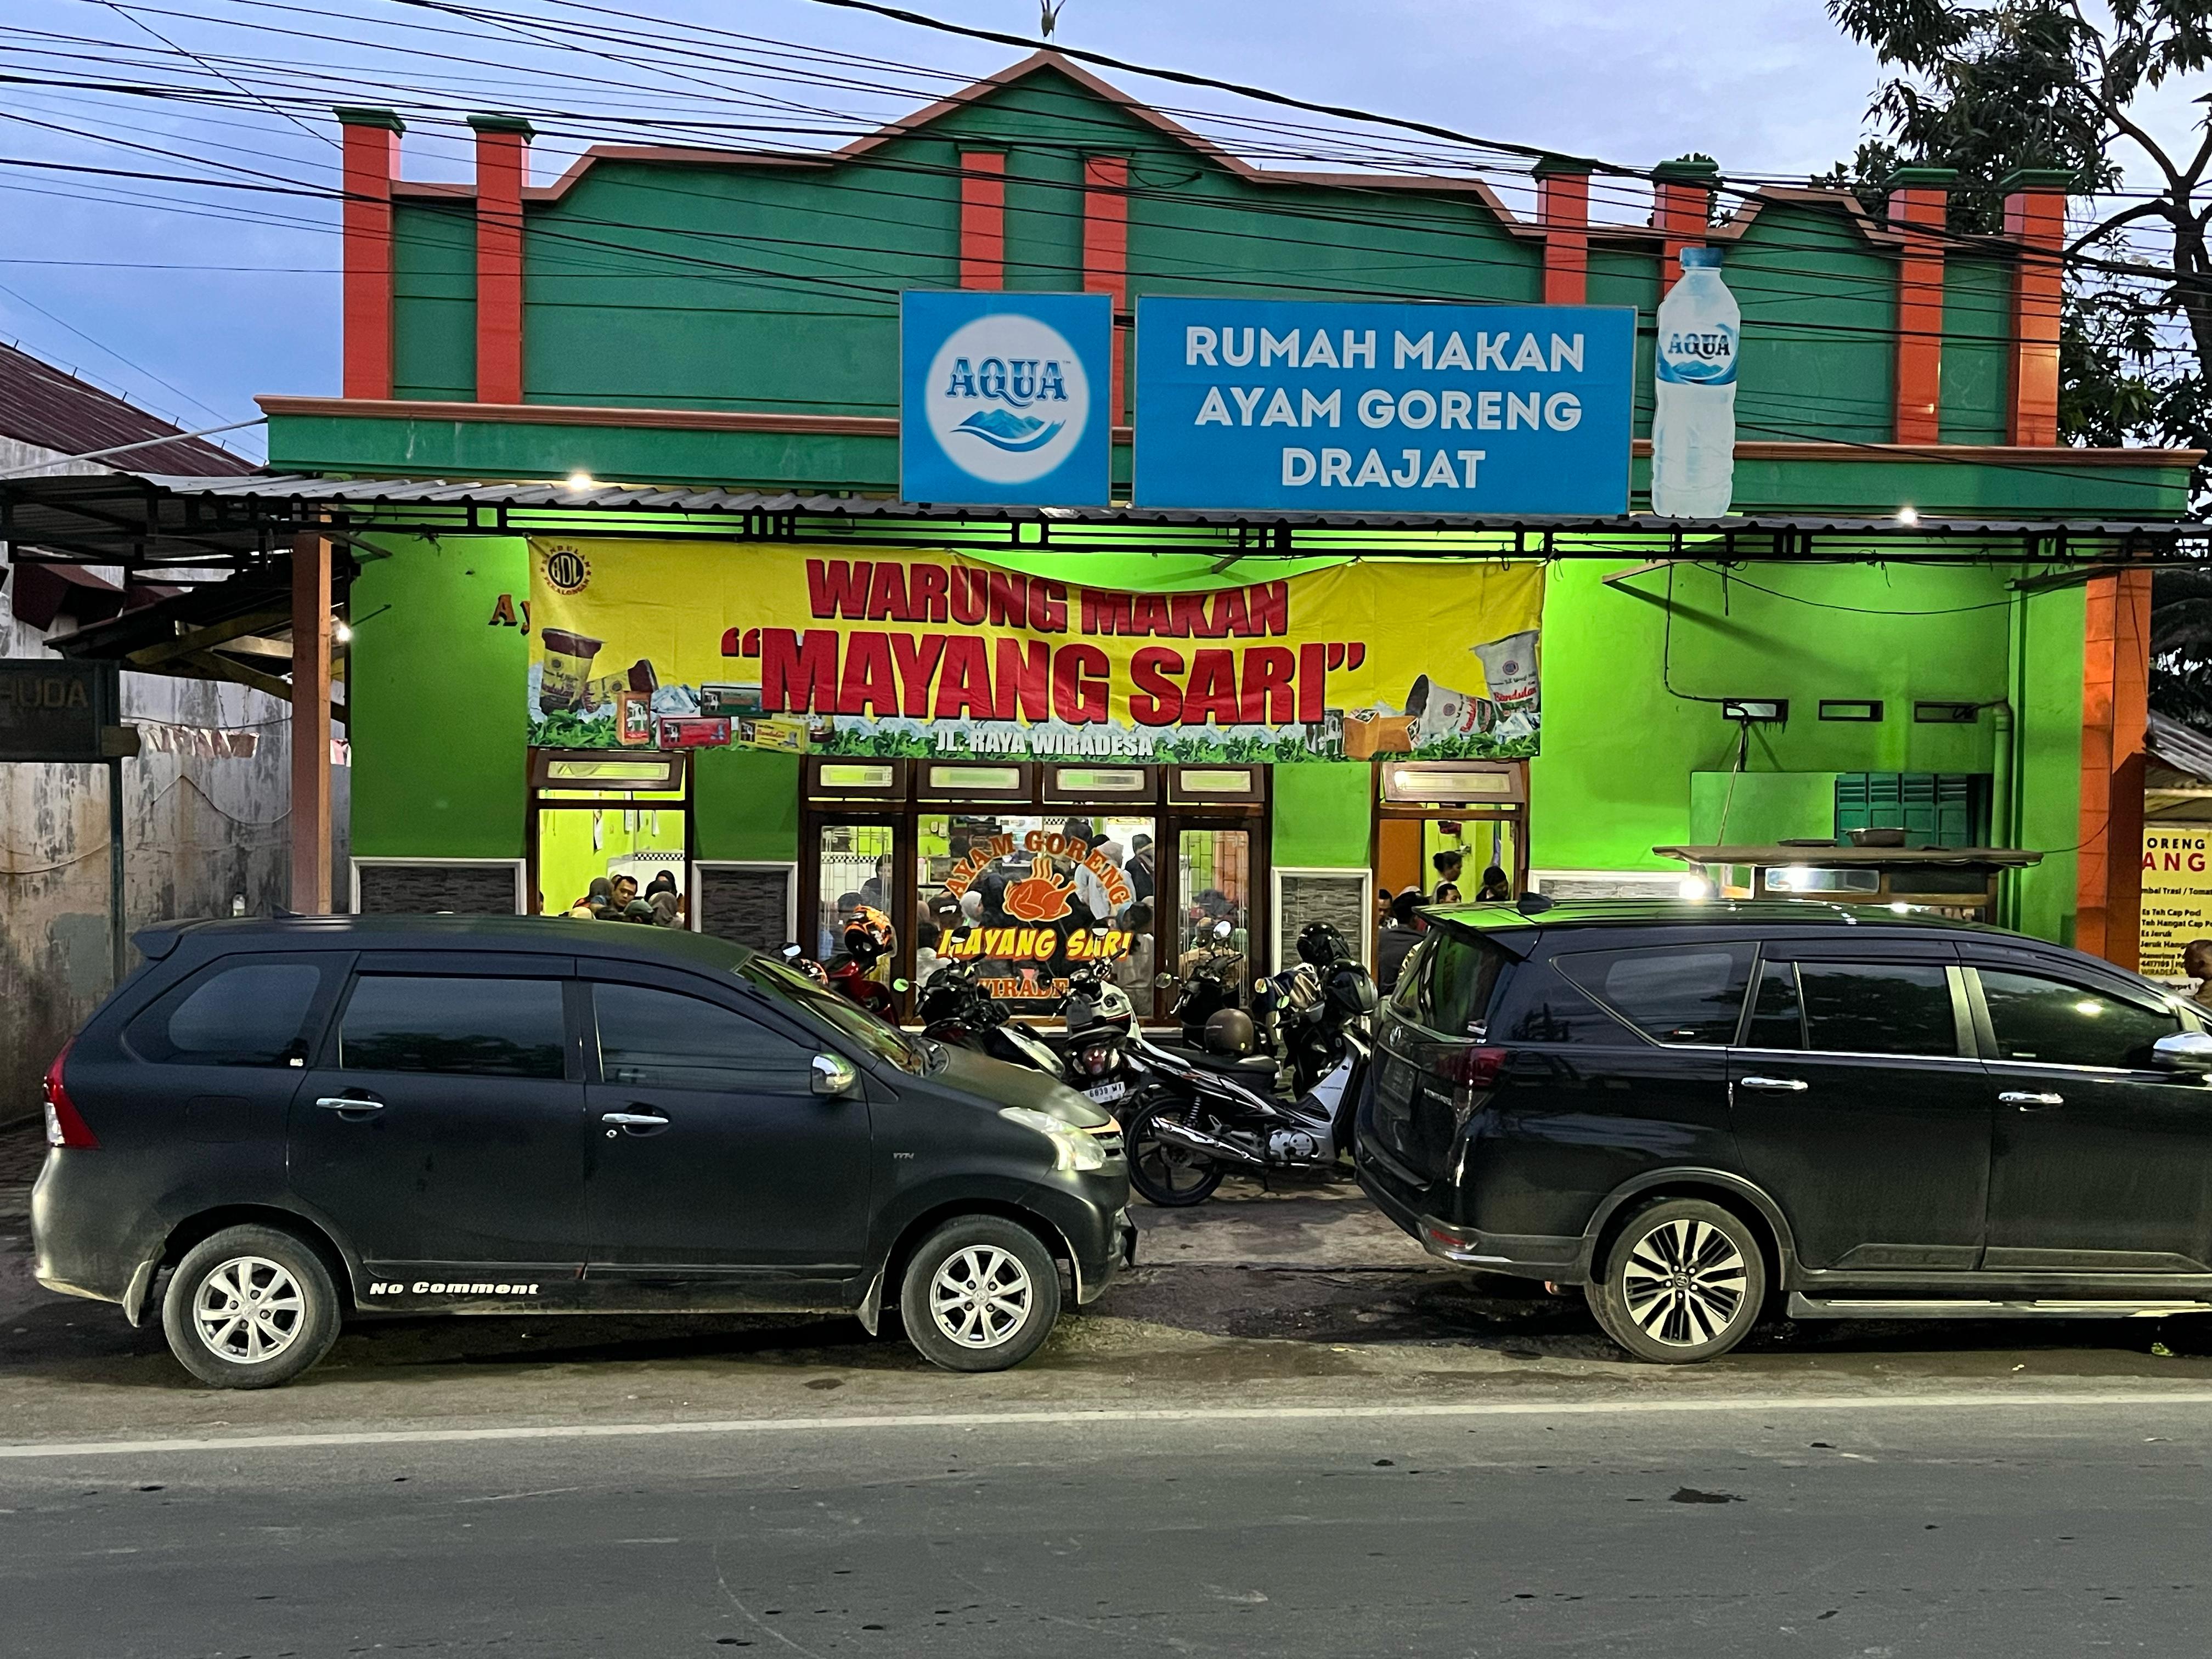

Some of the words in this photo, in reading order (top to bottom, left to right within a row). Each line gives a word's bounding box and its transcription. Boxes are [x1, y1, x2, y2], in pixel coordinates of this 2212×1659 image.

[1186, 325, 1376, 370] RUMAH
[1393, 330, 1584, 373] MAKAN
[1668, 332, 1731, 360] AQUA
[945, 356, 1069, 409] AQUA
[1194, 386, 1342, 428] AYAM
[1357, 388, 1582, 432] GORENG
[1282, 447, 1486, 489] DRAJAT
[805, 558, 1068, 634] WARUNG
[1081, 580, 1289, 639] MAKAN
[935, 730, 963, 752] JL.
[969, 730, 1026, 755] RAYA
[1033, 732, 1154, 758] WIRADESA
[2147, 837, 2205, 850] ORENG
[945, 832, 1016, 899] AYAM
[1024, 830, 1132, 907] GORENG
[2142, 851, 2205, 872] ANG
[2167, 909, 2183, 917] Cap
[2188, 919, 2203, 929] Cap
[370, 1282, 404, 1295] No
[412, 1281, 540, 1295] Comment
